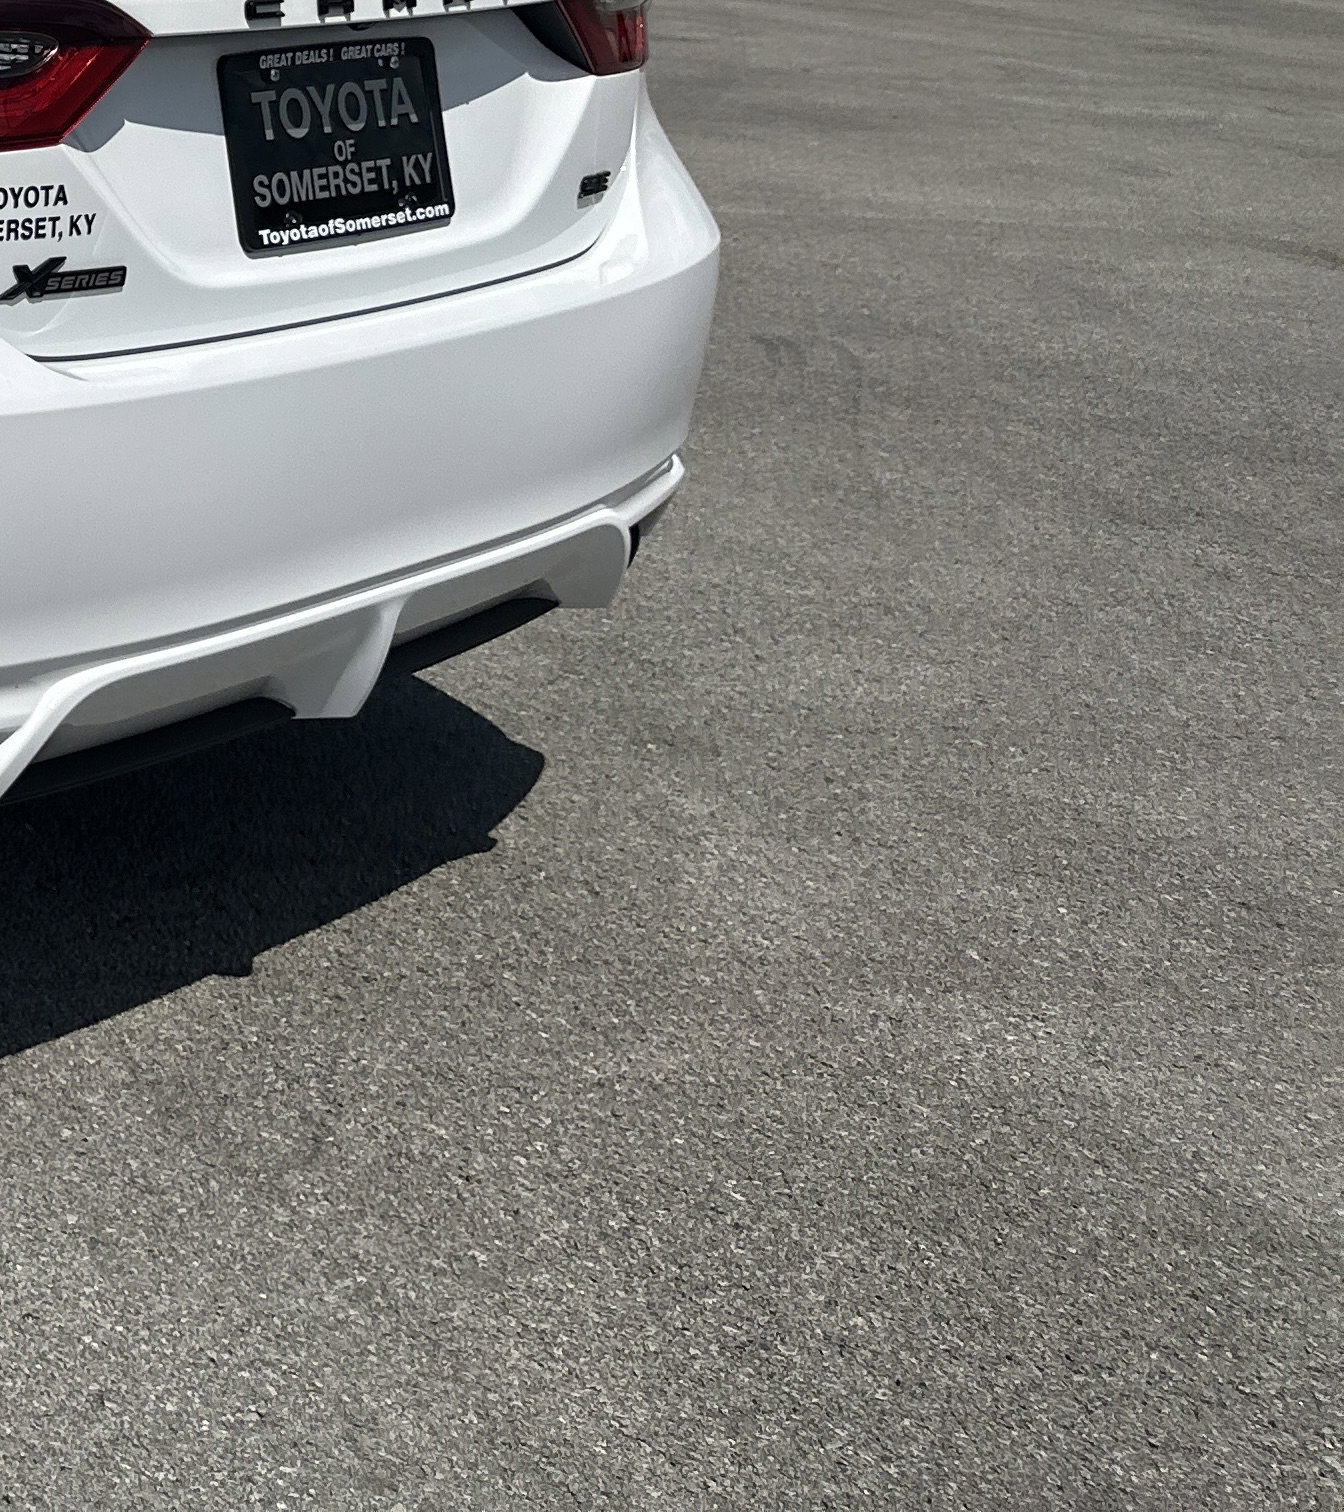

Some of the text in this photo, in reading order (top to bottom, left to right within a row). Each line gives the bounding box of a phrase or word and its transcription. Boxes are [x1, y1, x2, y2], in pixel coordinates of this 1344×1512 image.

[259, 52, 293, 69] GREAT
[341, 45, 373, 60] GREAT
[250, 77, 419, 141] TOYOTA
[333, 139, 356, 161] OF
[253, 152, 433, 208] SOMERSET, KY
[69, 213, 97, 237] KY
[258, 202, 449, 246] ToyotaofSomerset.com
